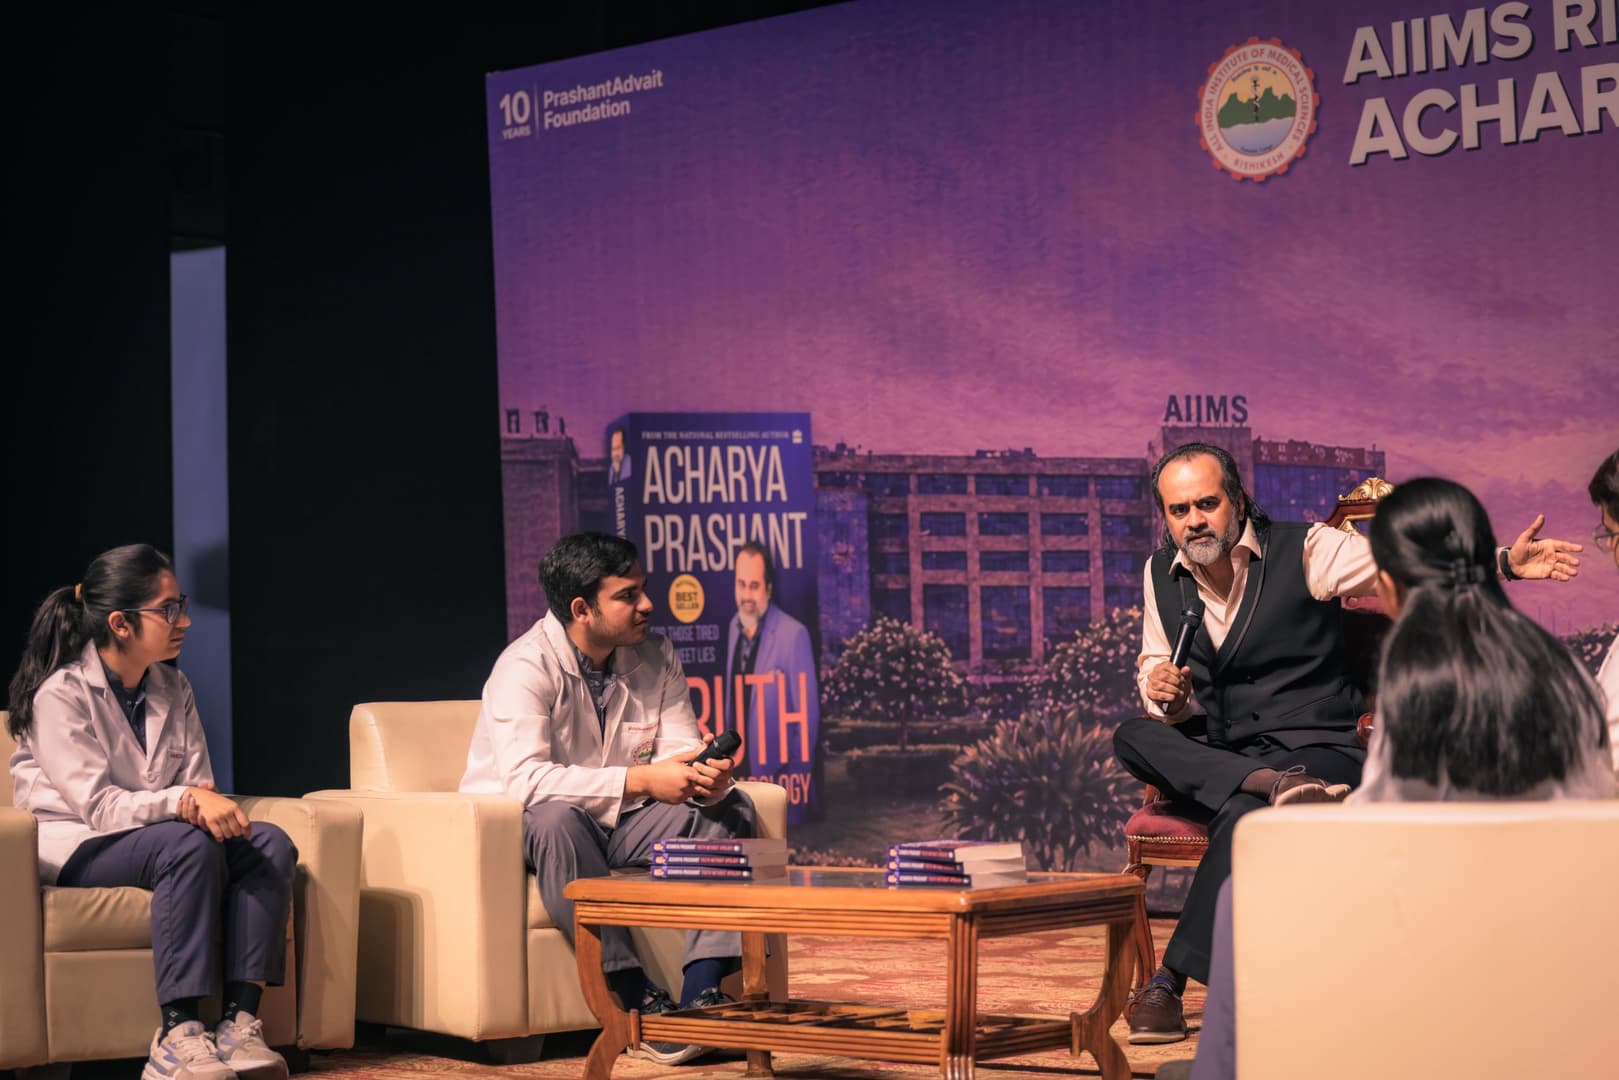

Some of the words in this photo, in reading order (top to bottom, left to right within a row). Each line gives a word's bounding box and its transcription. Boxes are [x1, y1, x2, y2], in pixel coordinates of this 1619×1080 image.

[1343, 2, 1533, 84] AIIMS
[1553, 0, 1618, 50] RI
[499, 91, 531, 126] 10
[543, 69, 664, 109] PrashantAdvait
[544, 99, 631, 130] Foundation
[1204, 99, 1214, 131] INDIA
[1210, 51, 1249, 95] INSTITUTE
[1250, 48, 1265, 58] OF
[1268, 50, 1304, 83] MEDICAL
[1291, 86, 1310, 141] SCIENCES
[1349, 63, 1619, 166] ACHAR
[502, 125, 531, 140] YEARS
[1233, 153, 1285, 169] RISHIKESH
[1163, 394, 1249, 423] AIIMS
[643, 445, 788, 504] ACHARYA
[615, 486, 627, 540] ACHARY
[644, 512, 808, 573] PRASHANT
[686, 671, 810, 769] RUTH
